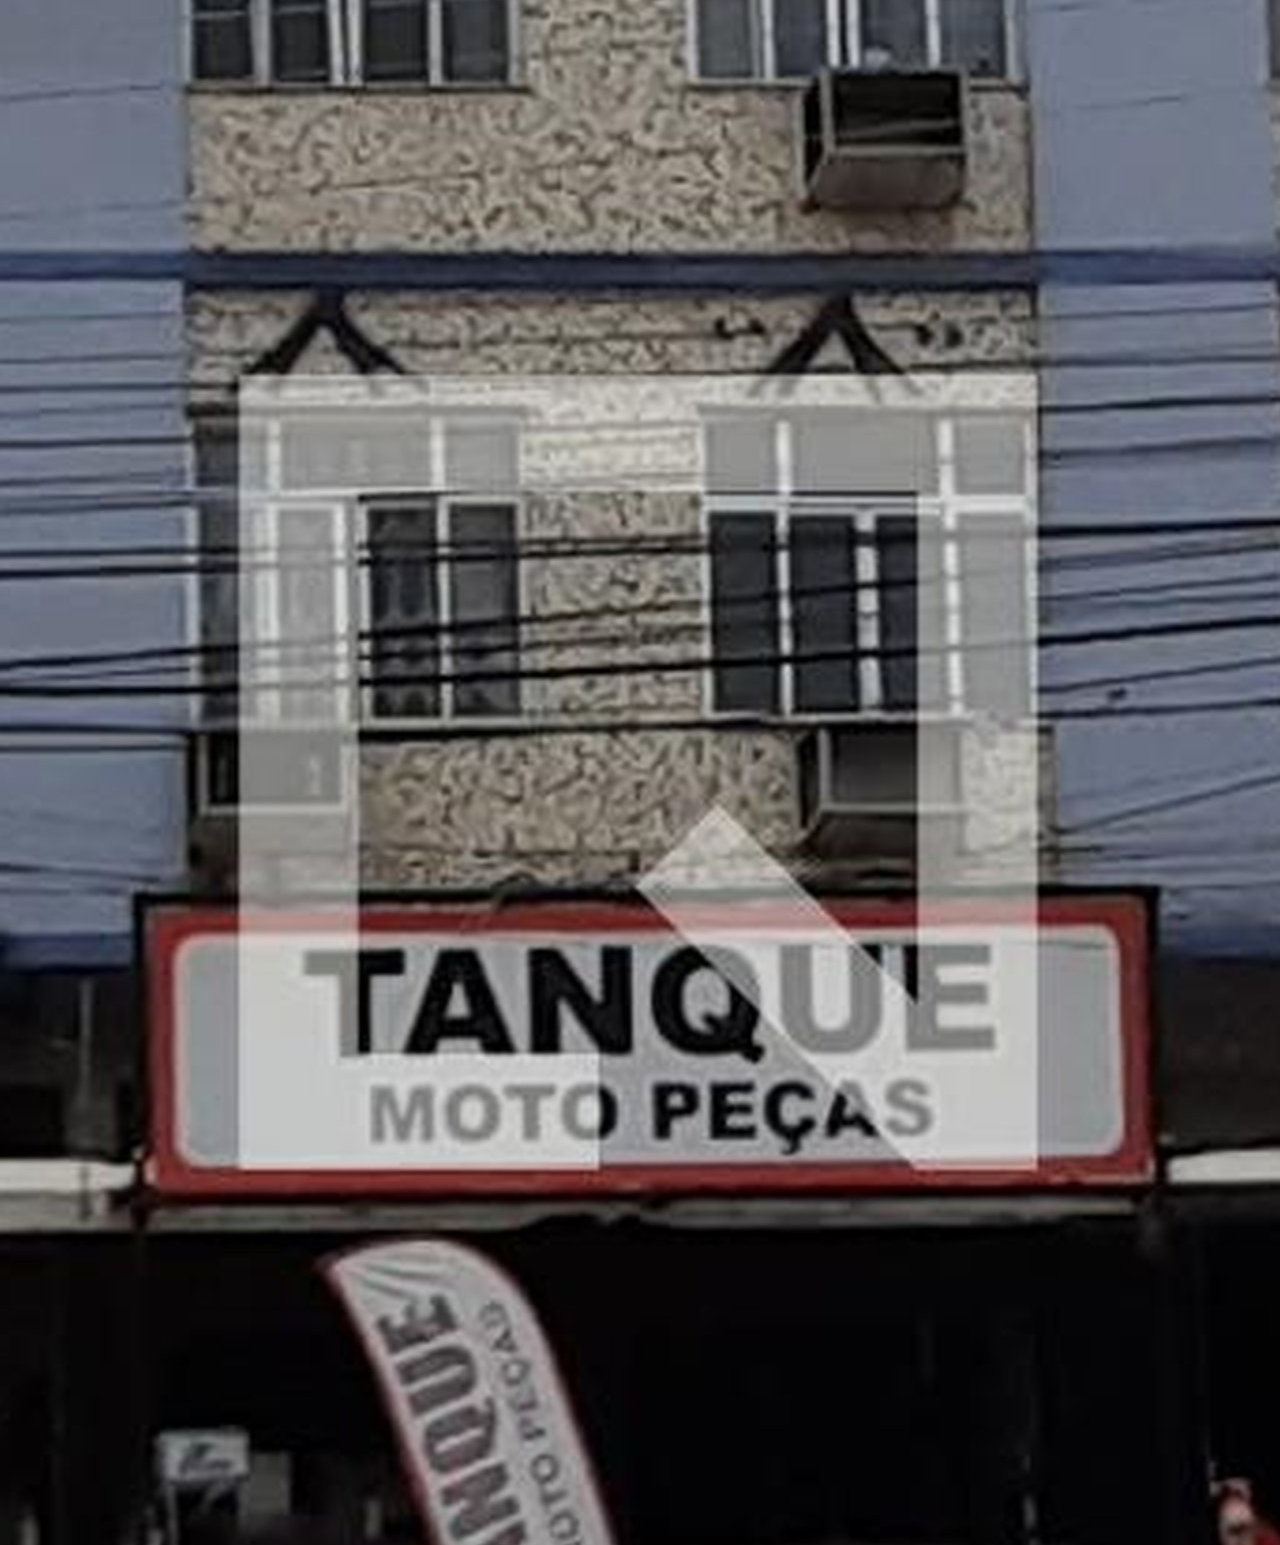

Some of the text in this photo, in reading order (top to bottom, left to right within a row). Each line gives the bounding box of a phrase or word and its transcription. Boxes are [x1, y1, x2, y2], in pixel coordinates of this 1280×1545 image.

[303, 943, 998, 1062] TANQUE
[369, 1079, 934, 1153] MOTO PEÇAS
